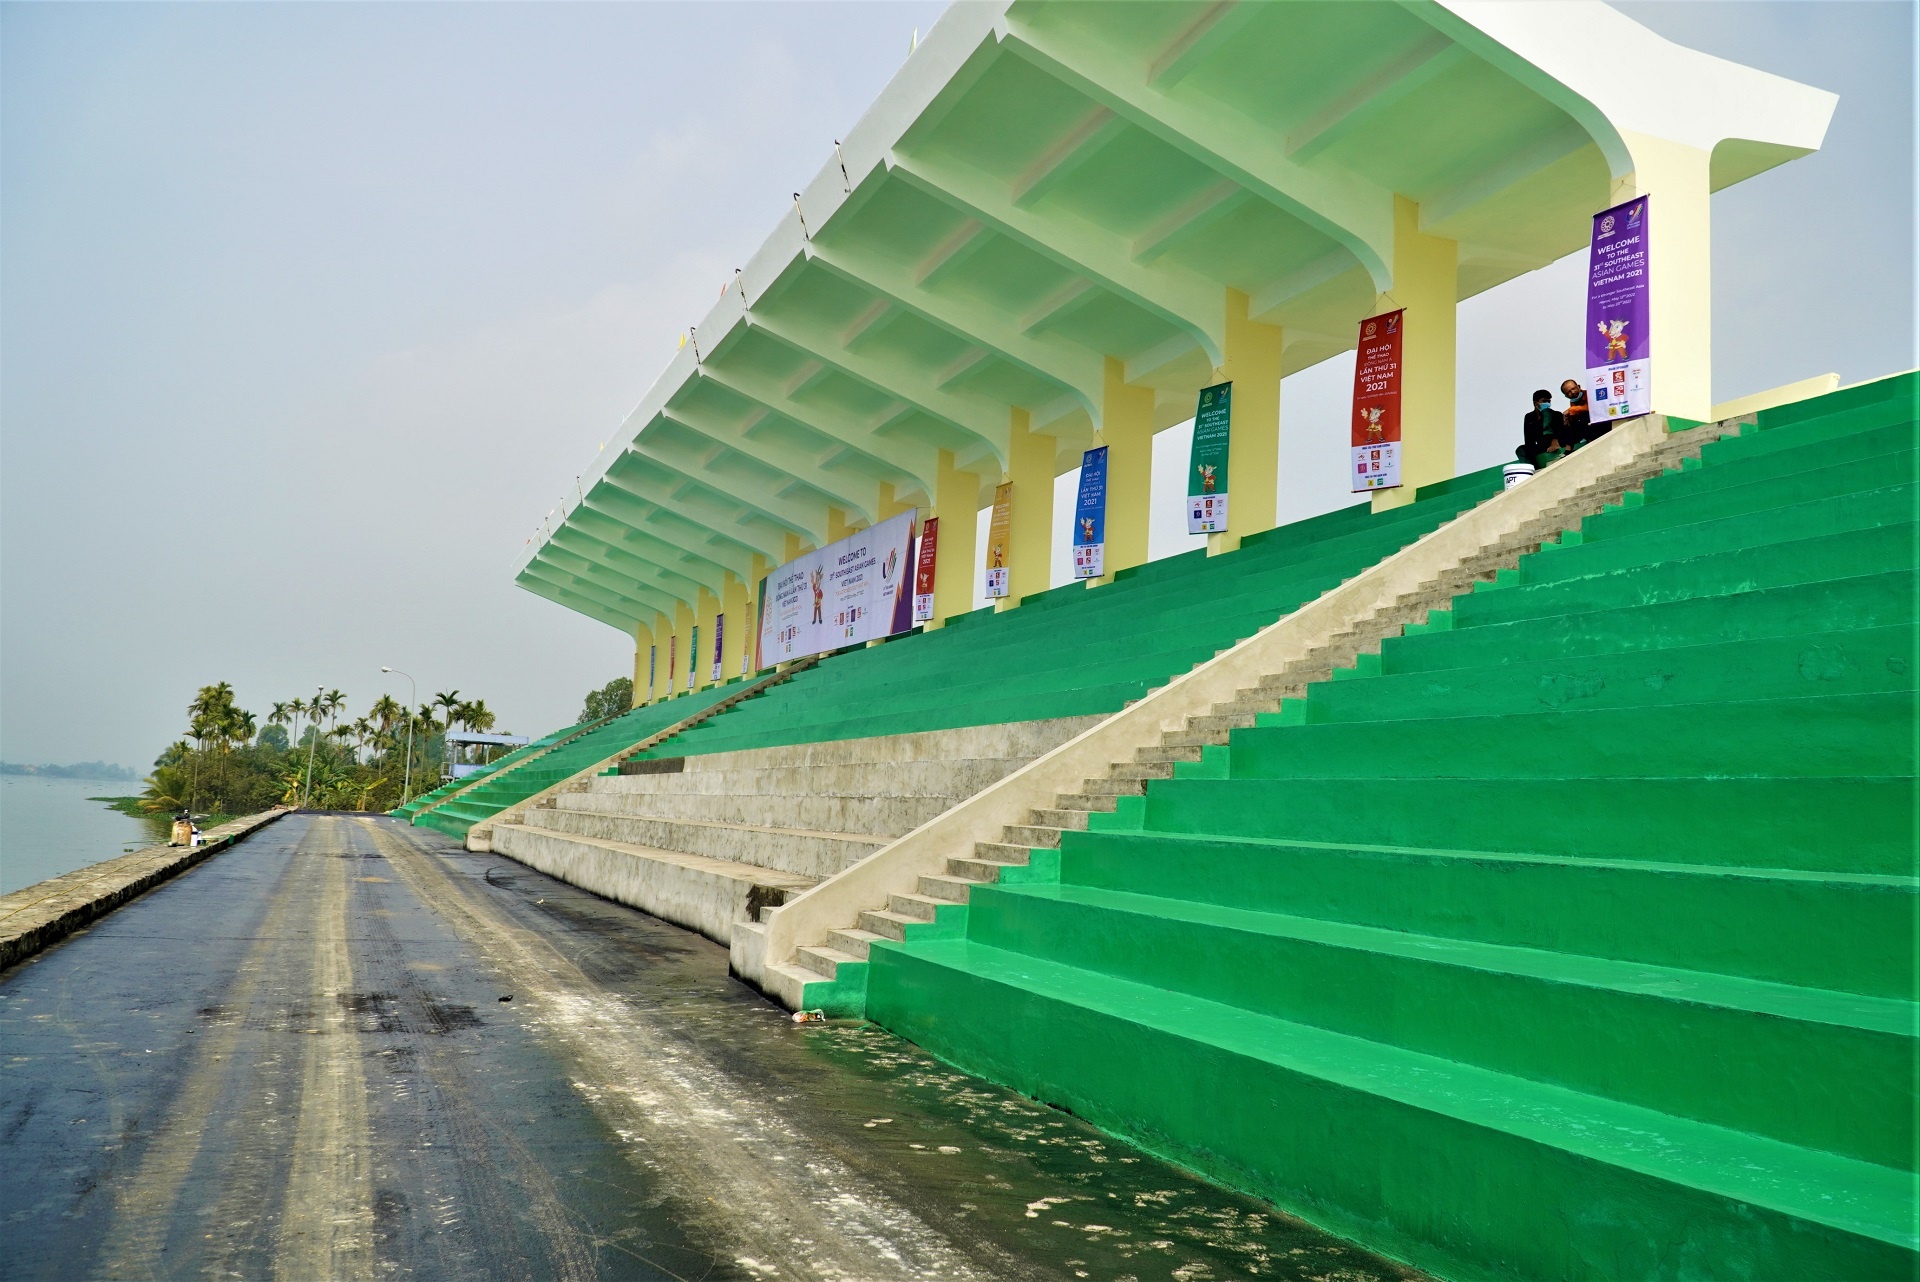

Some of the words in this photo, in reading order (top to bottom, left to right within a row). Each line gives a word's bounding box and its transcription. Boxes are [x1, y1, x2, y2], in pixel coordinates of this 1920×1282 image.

[1597, 235, 1640, 255] WELCOME
[1617, 248, 1629, 256] THE
[1604, 251, 1644, 268] SOUTHEAST
[1592, 267, 1614, 279] ASIAN
[1615, 259, 1645, 272] GAMES
[1593, 274, 1625, 287] VIETNAM
[1626, 269, 1642, 278] 2021
[1366, 347, 1378, 355] ĐẠI
[1379, 343, 1392, 352] HỘI
[1374, 363, 1389, 372] THỨ
[1360, 374, 1376, 383] VIỆT
[1376, 371, 1394, 380] NAM
[1366, 381, 1387, 392] 2021
[1201, 408, 1227, 418] WELCOME
[1204, 420, 1228, 428] SOUTHEAST
[1084, 498, 1097, 506] 2021
[838, 549, 860, 566] WELCOME
[860, 546, 867, 557] TO
